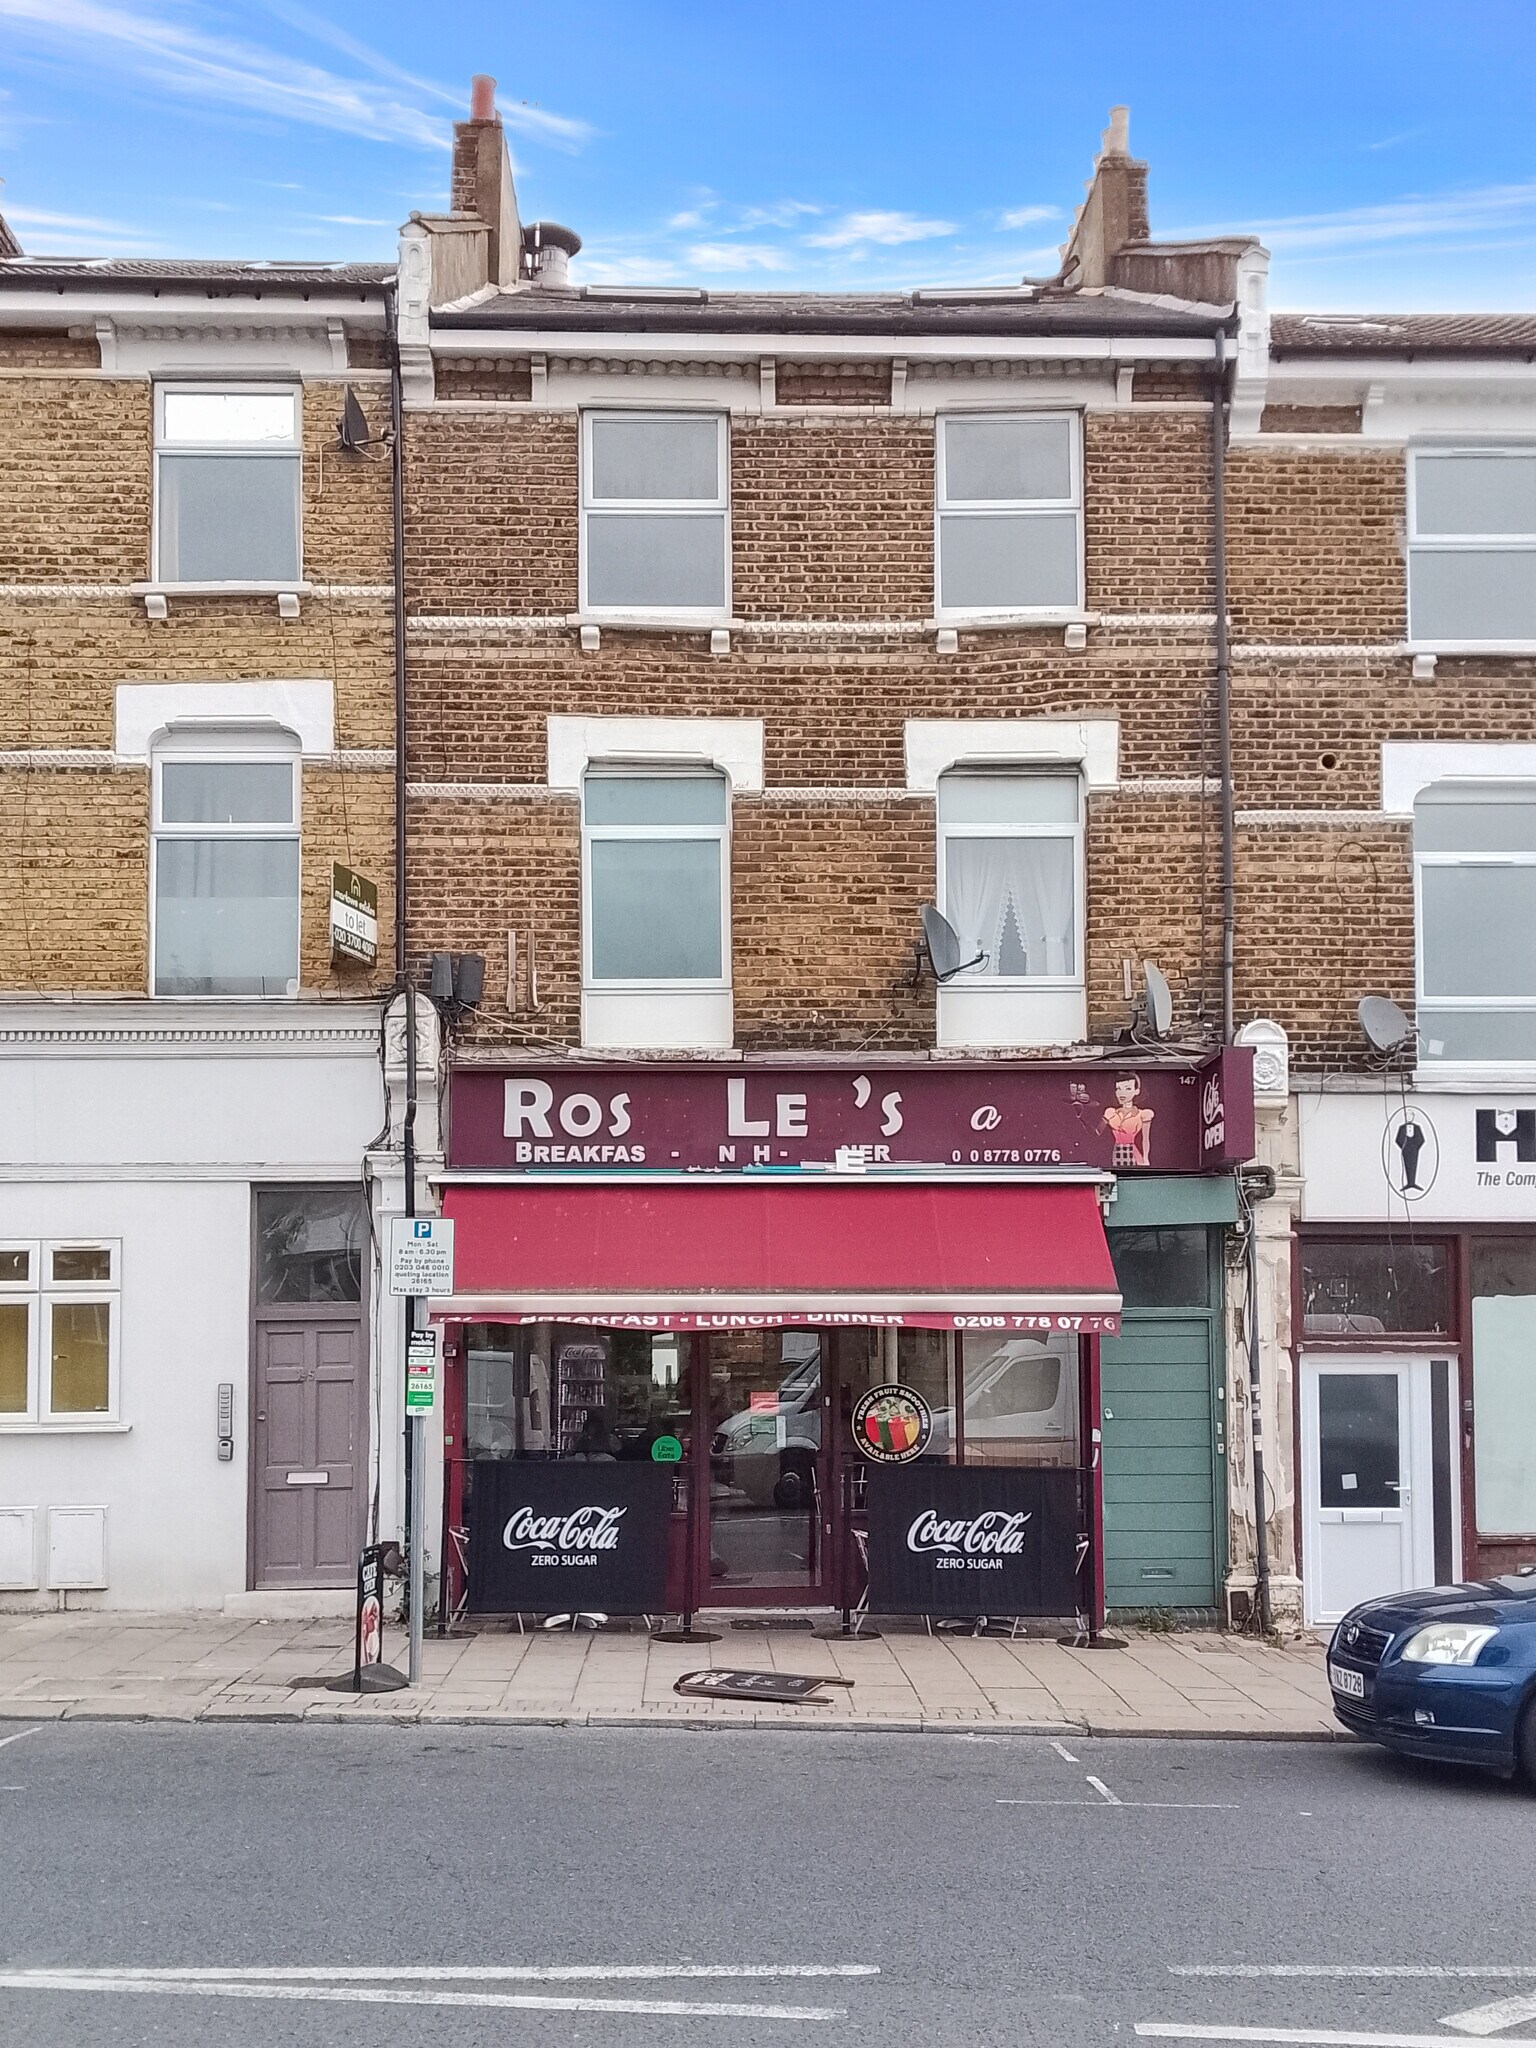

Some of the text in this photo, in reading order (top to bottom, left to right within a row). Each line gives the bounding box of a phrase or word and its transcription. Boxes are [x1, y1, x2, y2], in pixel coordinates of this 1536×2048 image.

[345, 911, 366, 935] to let
[1178, 1076, 1196, 1085] 147
[1204, 1121, 1225, 1150] OPEN
[515, 1141, 646, 1162] BREAKFAS
[983, 1149, 1020, 1162] 8778
[1024, 1149, 1061, 1162] 0776
[1476, 1171, 1501, 1186] The
[696, 1315, 783, 1326] LUNCH
[807, 1313, 905, 1324] DINNER
[952, 1315, 1006, 1328] 0208
[1011, 1315, 1052, 1328] 778
[411, 1331, 434, 1339] Pay by
[856, 1388, 929, 1430] FRESH FRUIT SMOOTHIES
[657, 1451, 675, 1459] Eats
[860, 1437, 921, 1461] AVAILABLE HERE
[530, 1555, 598, 1566] ZERO SUGAR
[936, 1558, 1003, 1570] ZERO SUGAR
